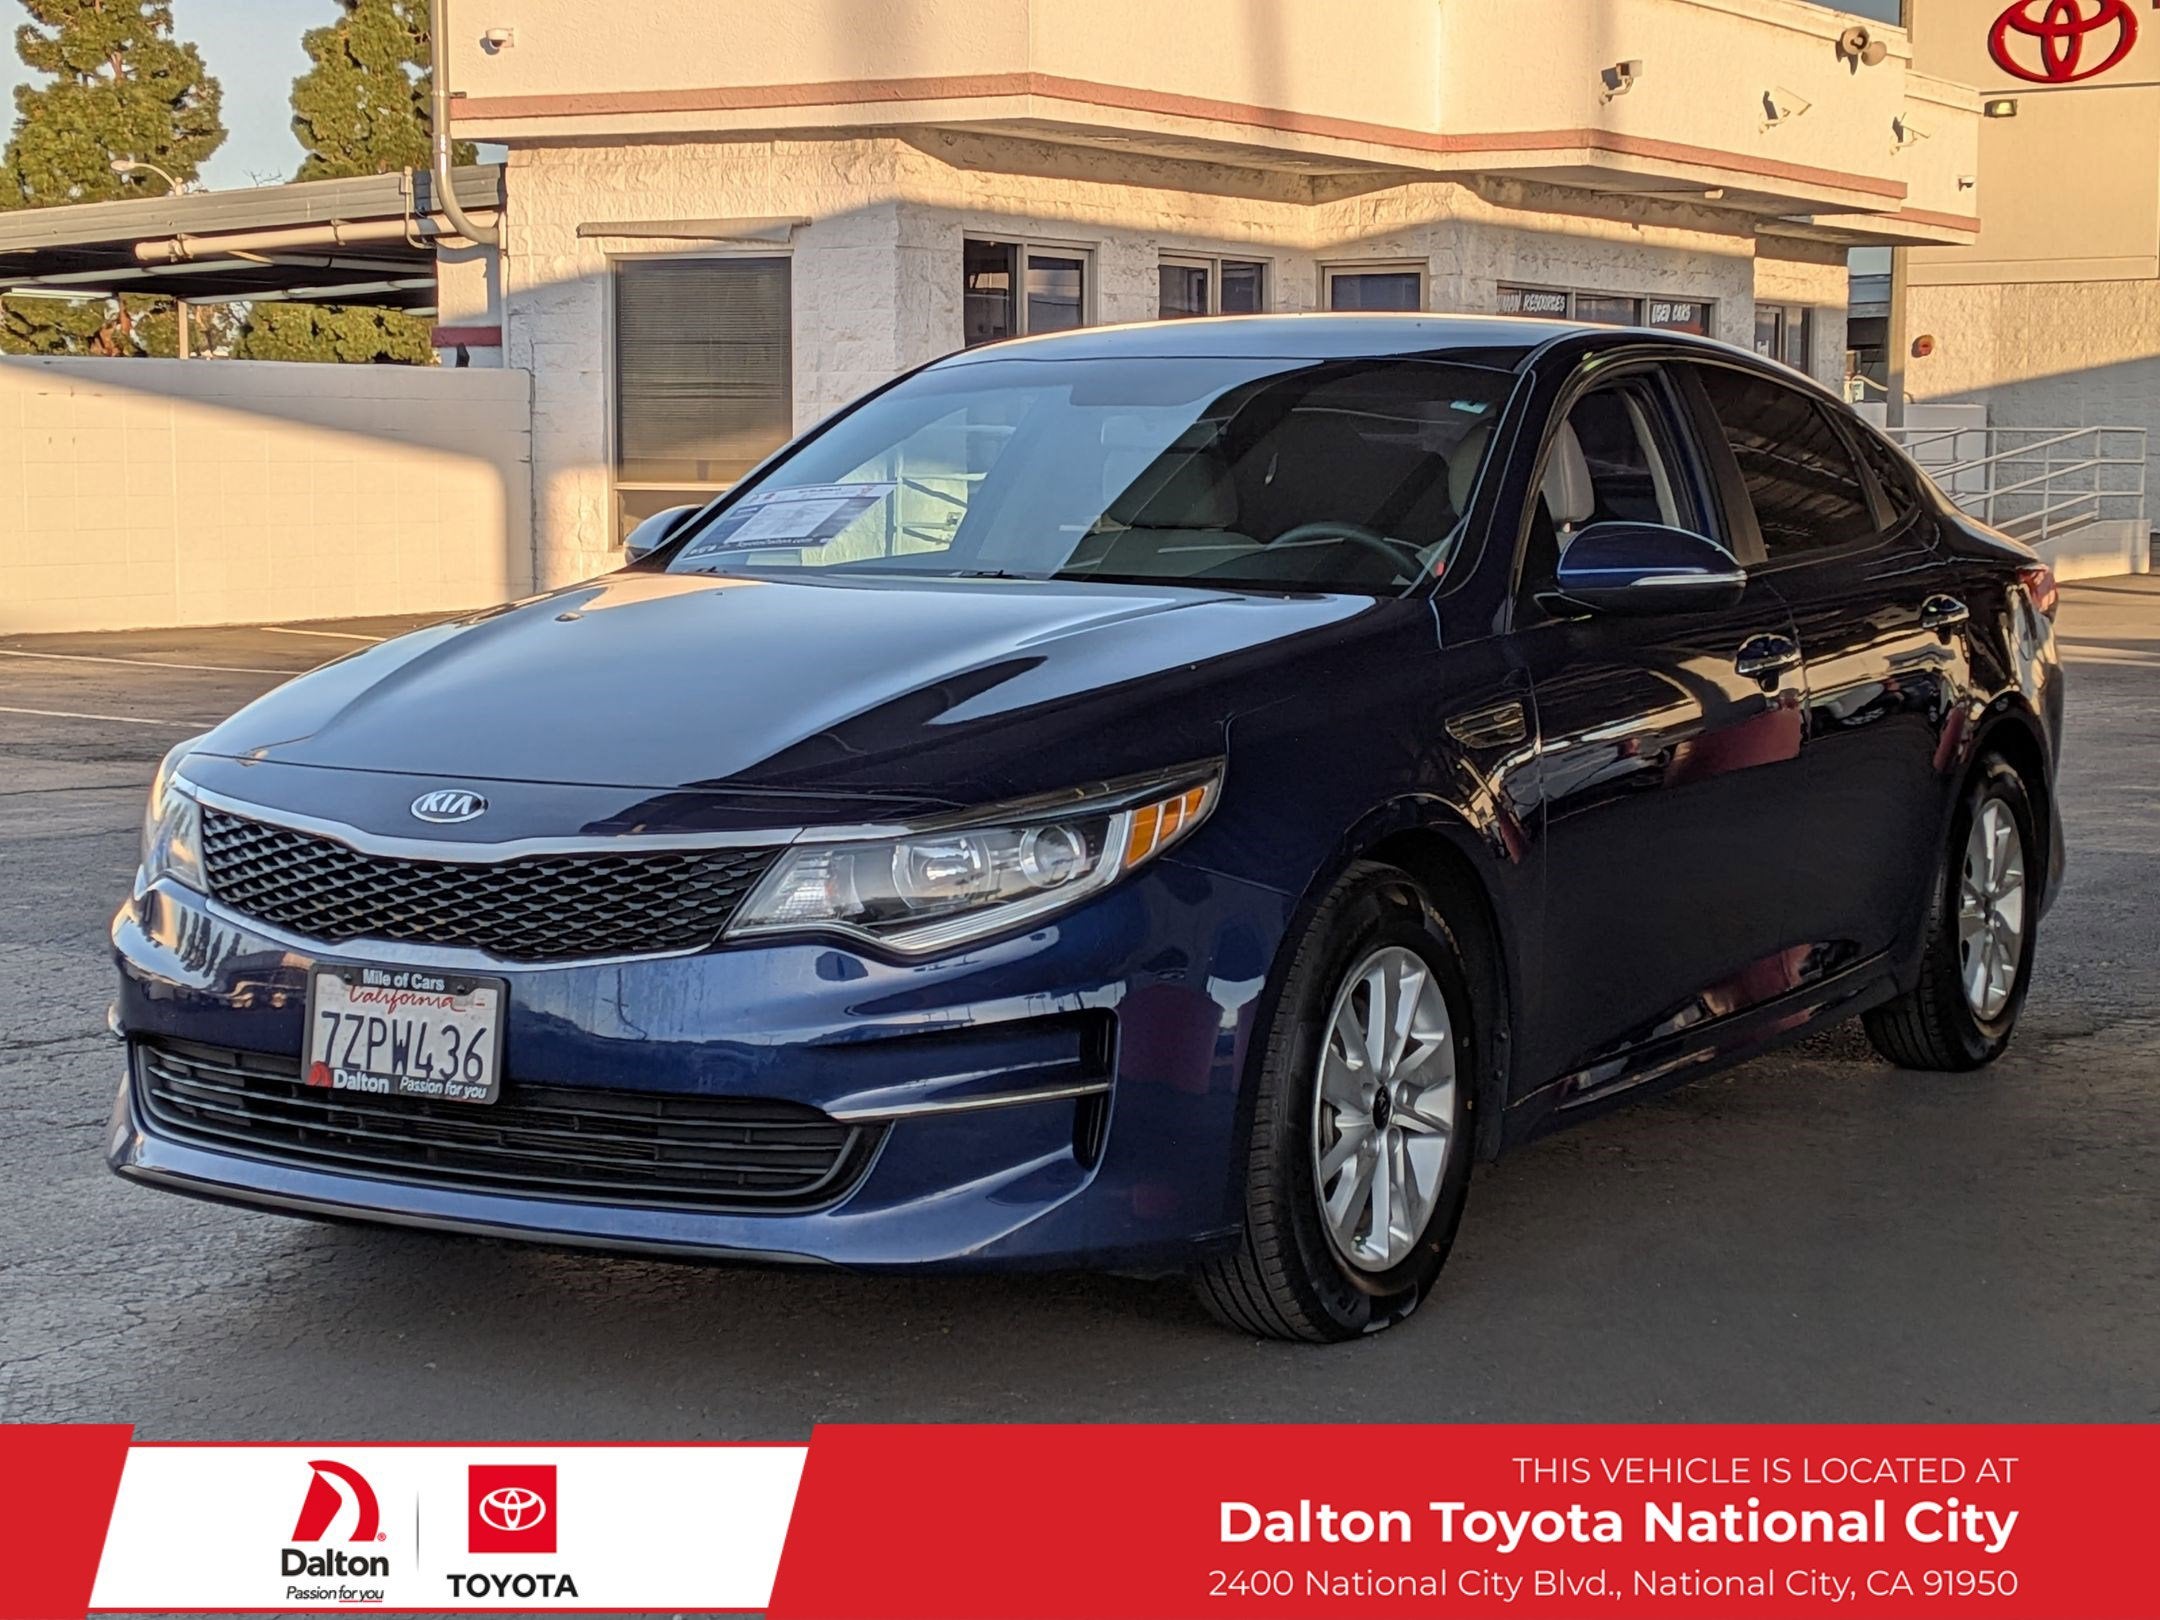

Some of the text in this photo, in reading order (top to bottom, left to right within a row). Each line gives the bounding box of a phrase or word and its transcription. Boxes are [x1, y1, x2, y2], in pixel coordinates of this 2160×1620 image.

[1651, 303, 1691, 324] USED CARS
[420, 793, 473, 815] KIA
[362, 968, 445, 991] Mile of Cars
[349, 985, 466, 1014] California
[320, 1010, 488, 1083] 7ZPW436
[333, 1069, 487, 1099] Dalton Passion for you
